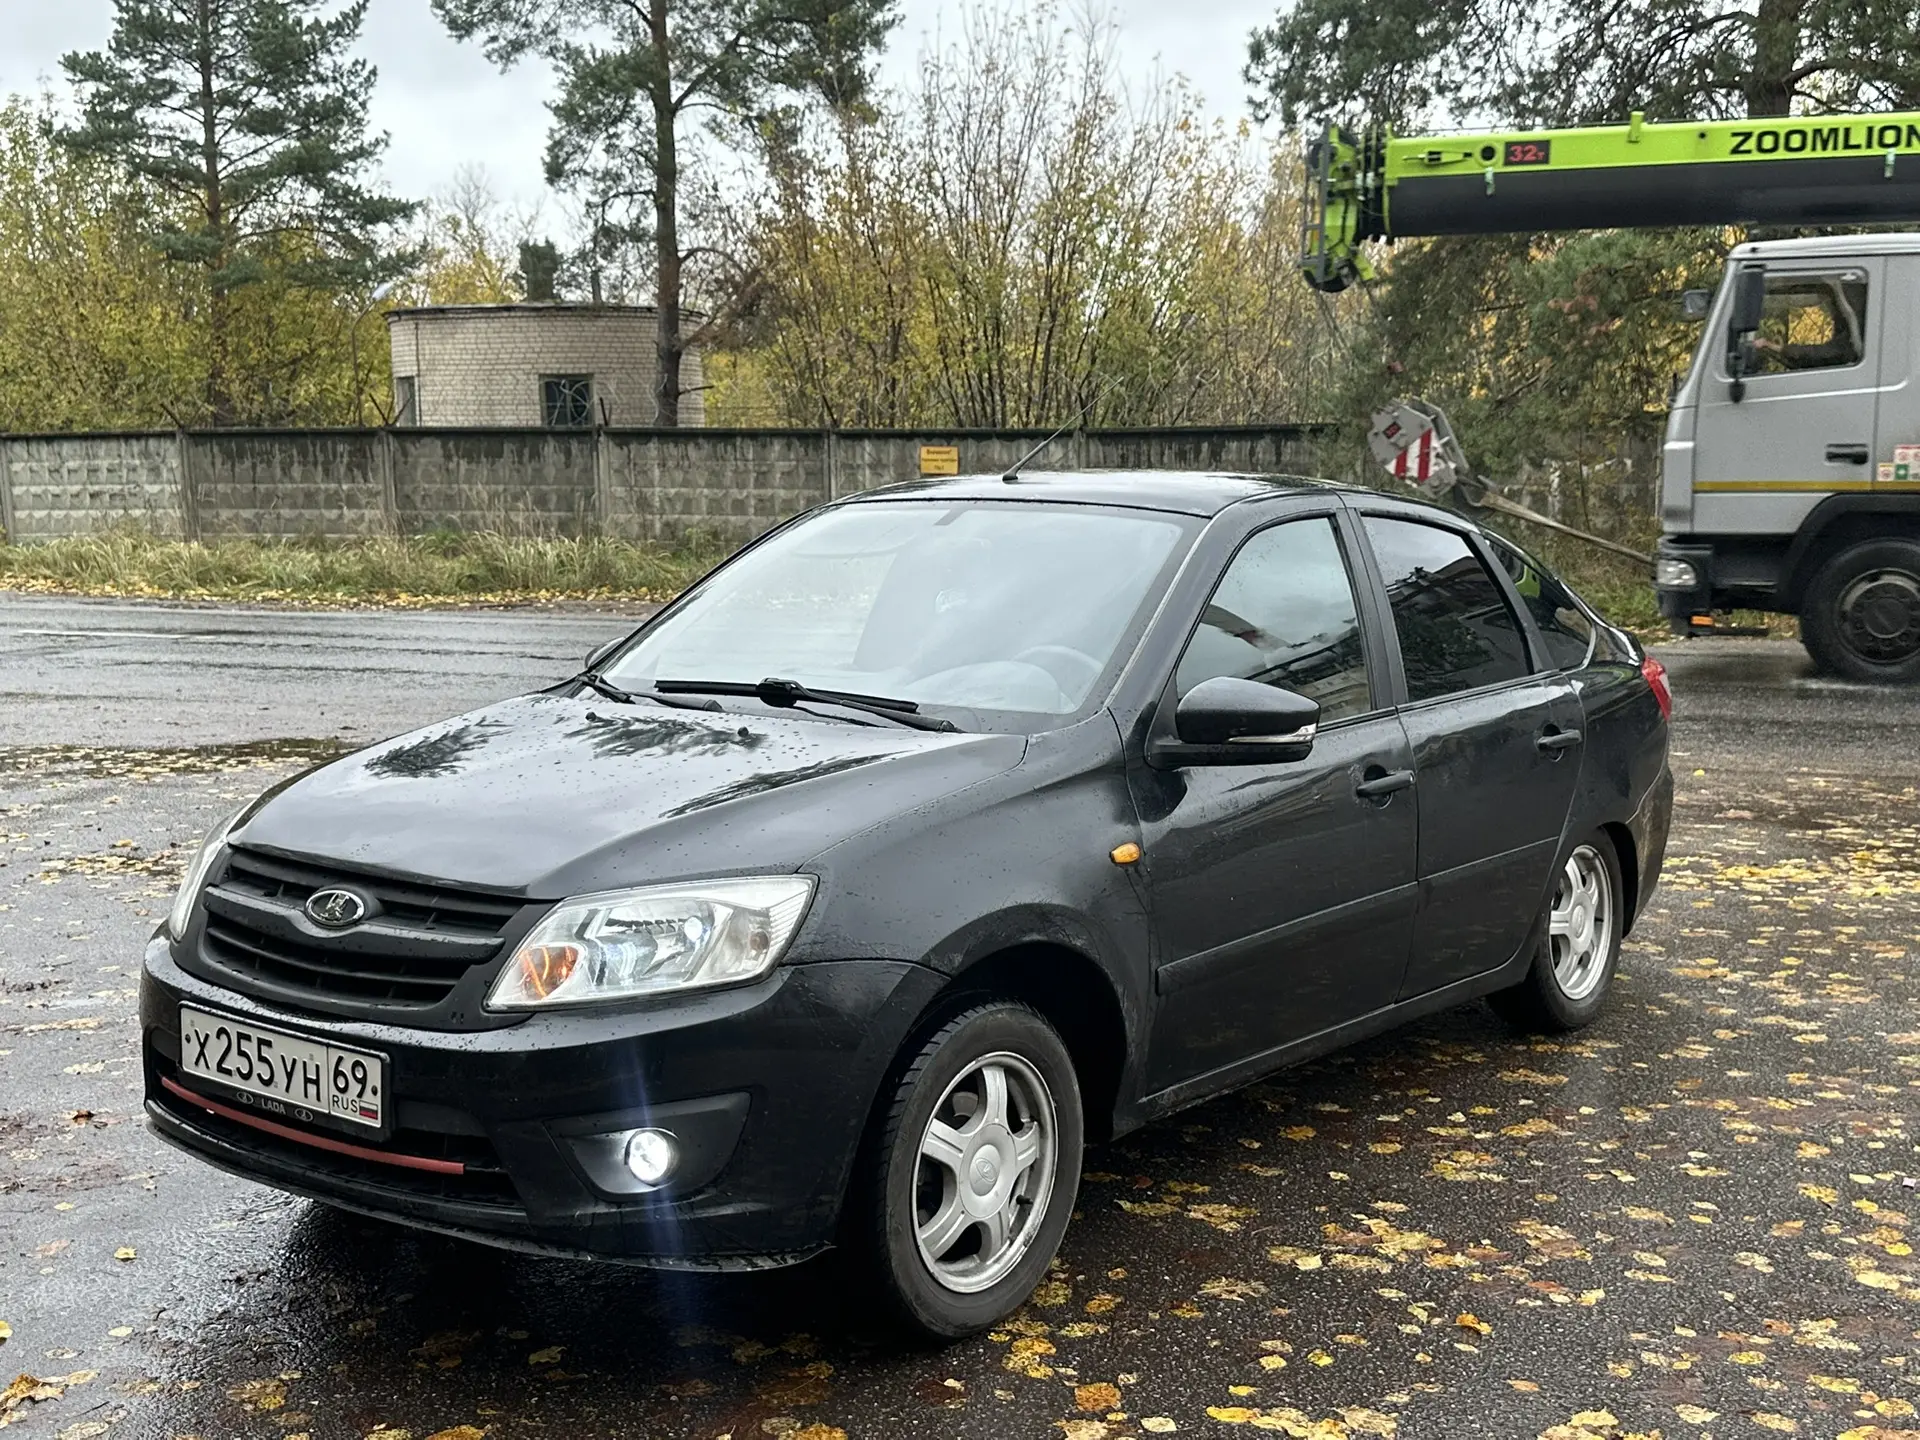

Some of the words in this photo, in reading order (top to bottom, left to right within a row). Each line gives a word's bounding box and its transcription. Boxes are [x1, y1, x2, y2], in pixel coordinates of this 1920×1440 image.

[1730, 124, 1920, 155] ZOOMLION
[261, 1098, 286, 1115] LADA
[332, 1094, 358, 1113] RUS
